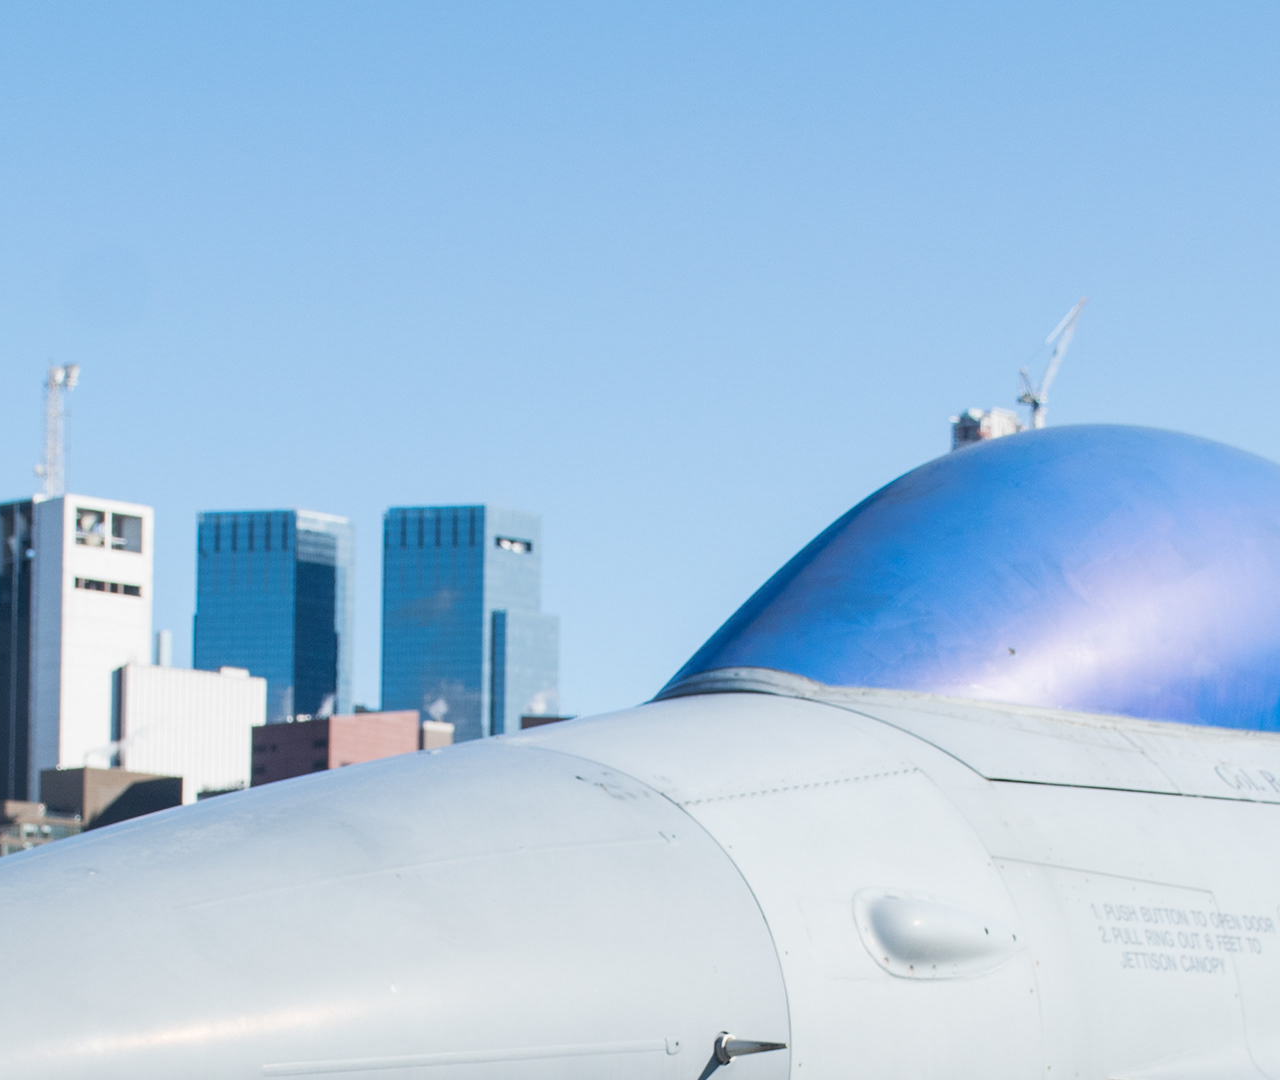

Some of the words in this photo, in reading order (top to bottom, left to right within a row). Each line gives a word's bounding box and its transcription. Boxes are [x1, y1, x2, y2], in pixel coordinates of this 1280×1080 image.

[1214, 766, 1266, 792] Col.
[1102, 904, 1139, 922] PUSH
[1139, 906, 1189, 925] BUTTON
[1190, 910, 1208, 928] TO
[1209, 912, 1242, 930] OPEN
[1242, 915, 1276, 933] DOOR
[1111, 927, 1143, 946] PULL
[1144, 929, 1175, 947] RING
[1177, 931, 1201, 949] OUT
[1204, 933, 1214, 950] 6
[1215, 935, 1244, 952] FEET
[1245, 937, 1262, 954] TO
[1121, 951, 1178, 971] JETTISON
[1180, 954, 1225, 974] CANOPY
